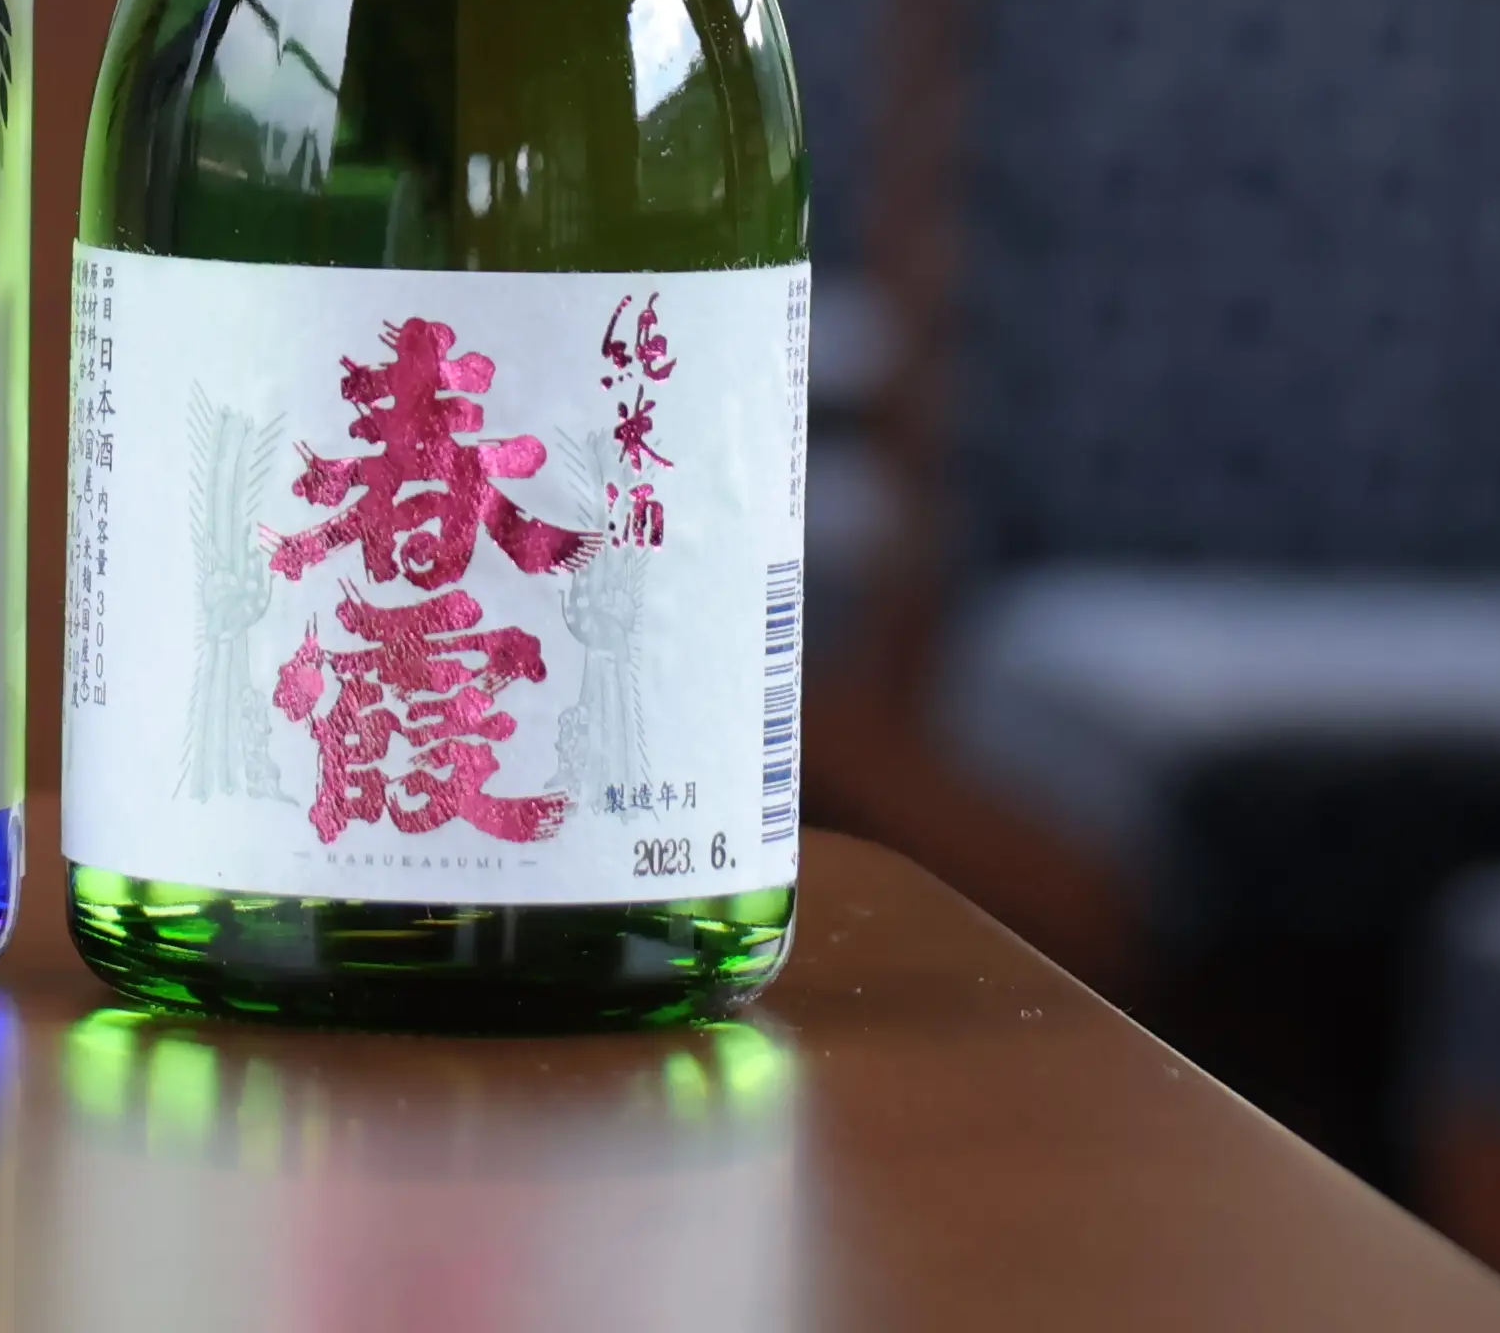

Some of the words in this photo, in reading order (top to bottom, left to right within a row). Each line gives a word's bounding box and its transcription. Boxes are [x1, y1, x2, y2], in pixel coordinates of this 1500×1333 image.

[86, 263, 98, 382] 原材料名
[102, 266, 114, 321] 品目
[95, 337, 117, 473] 日本酒
[599, 291, 677, 551] 純米酒
[96, 486, 109, 576] 内容量
[257, 316, 606, 845] 春霞
[603, 781, 698, 814] 製造年月
[327, 851, 503, 870] HARUKASUMI
[632, 837, 697, 878] 2023.
[710, 830, 737, 871] 6.
